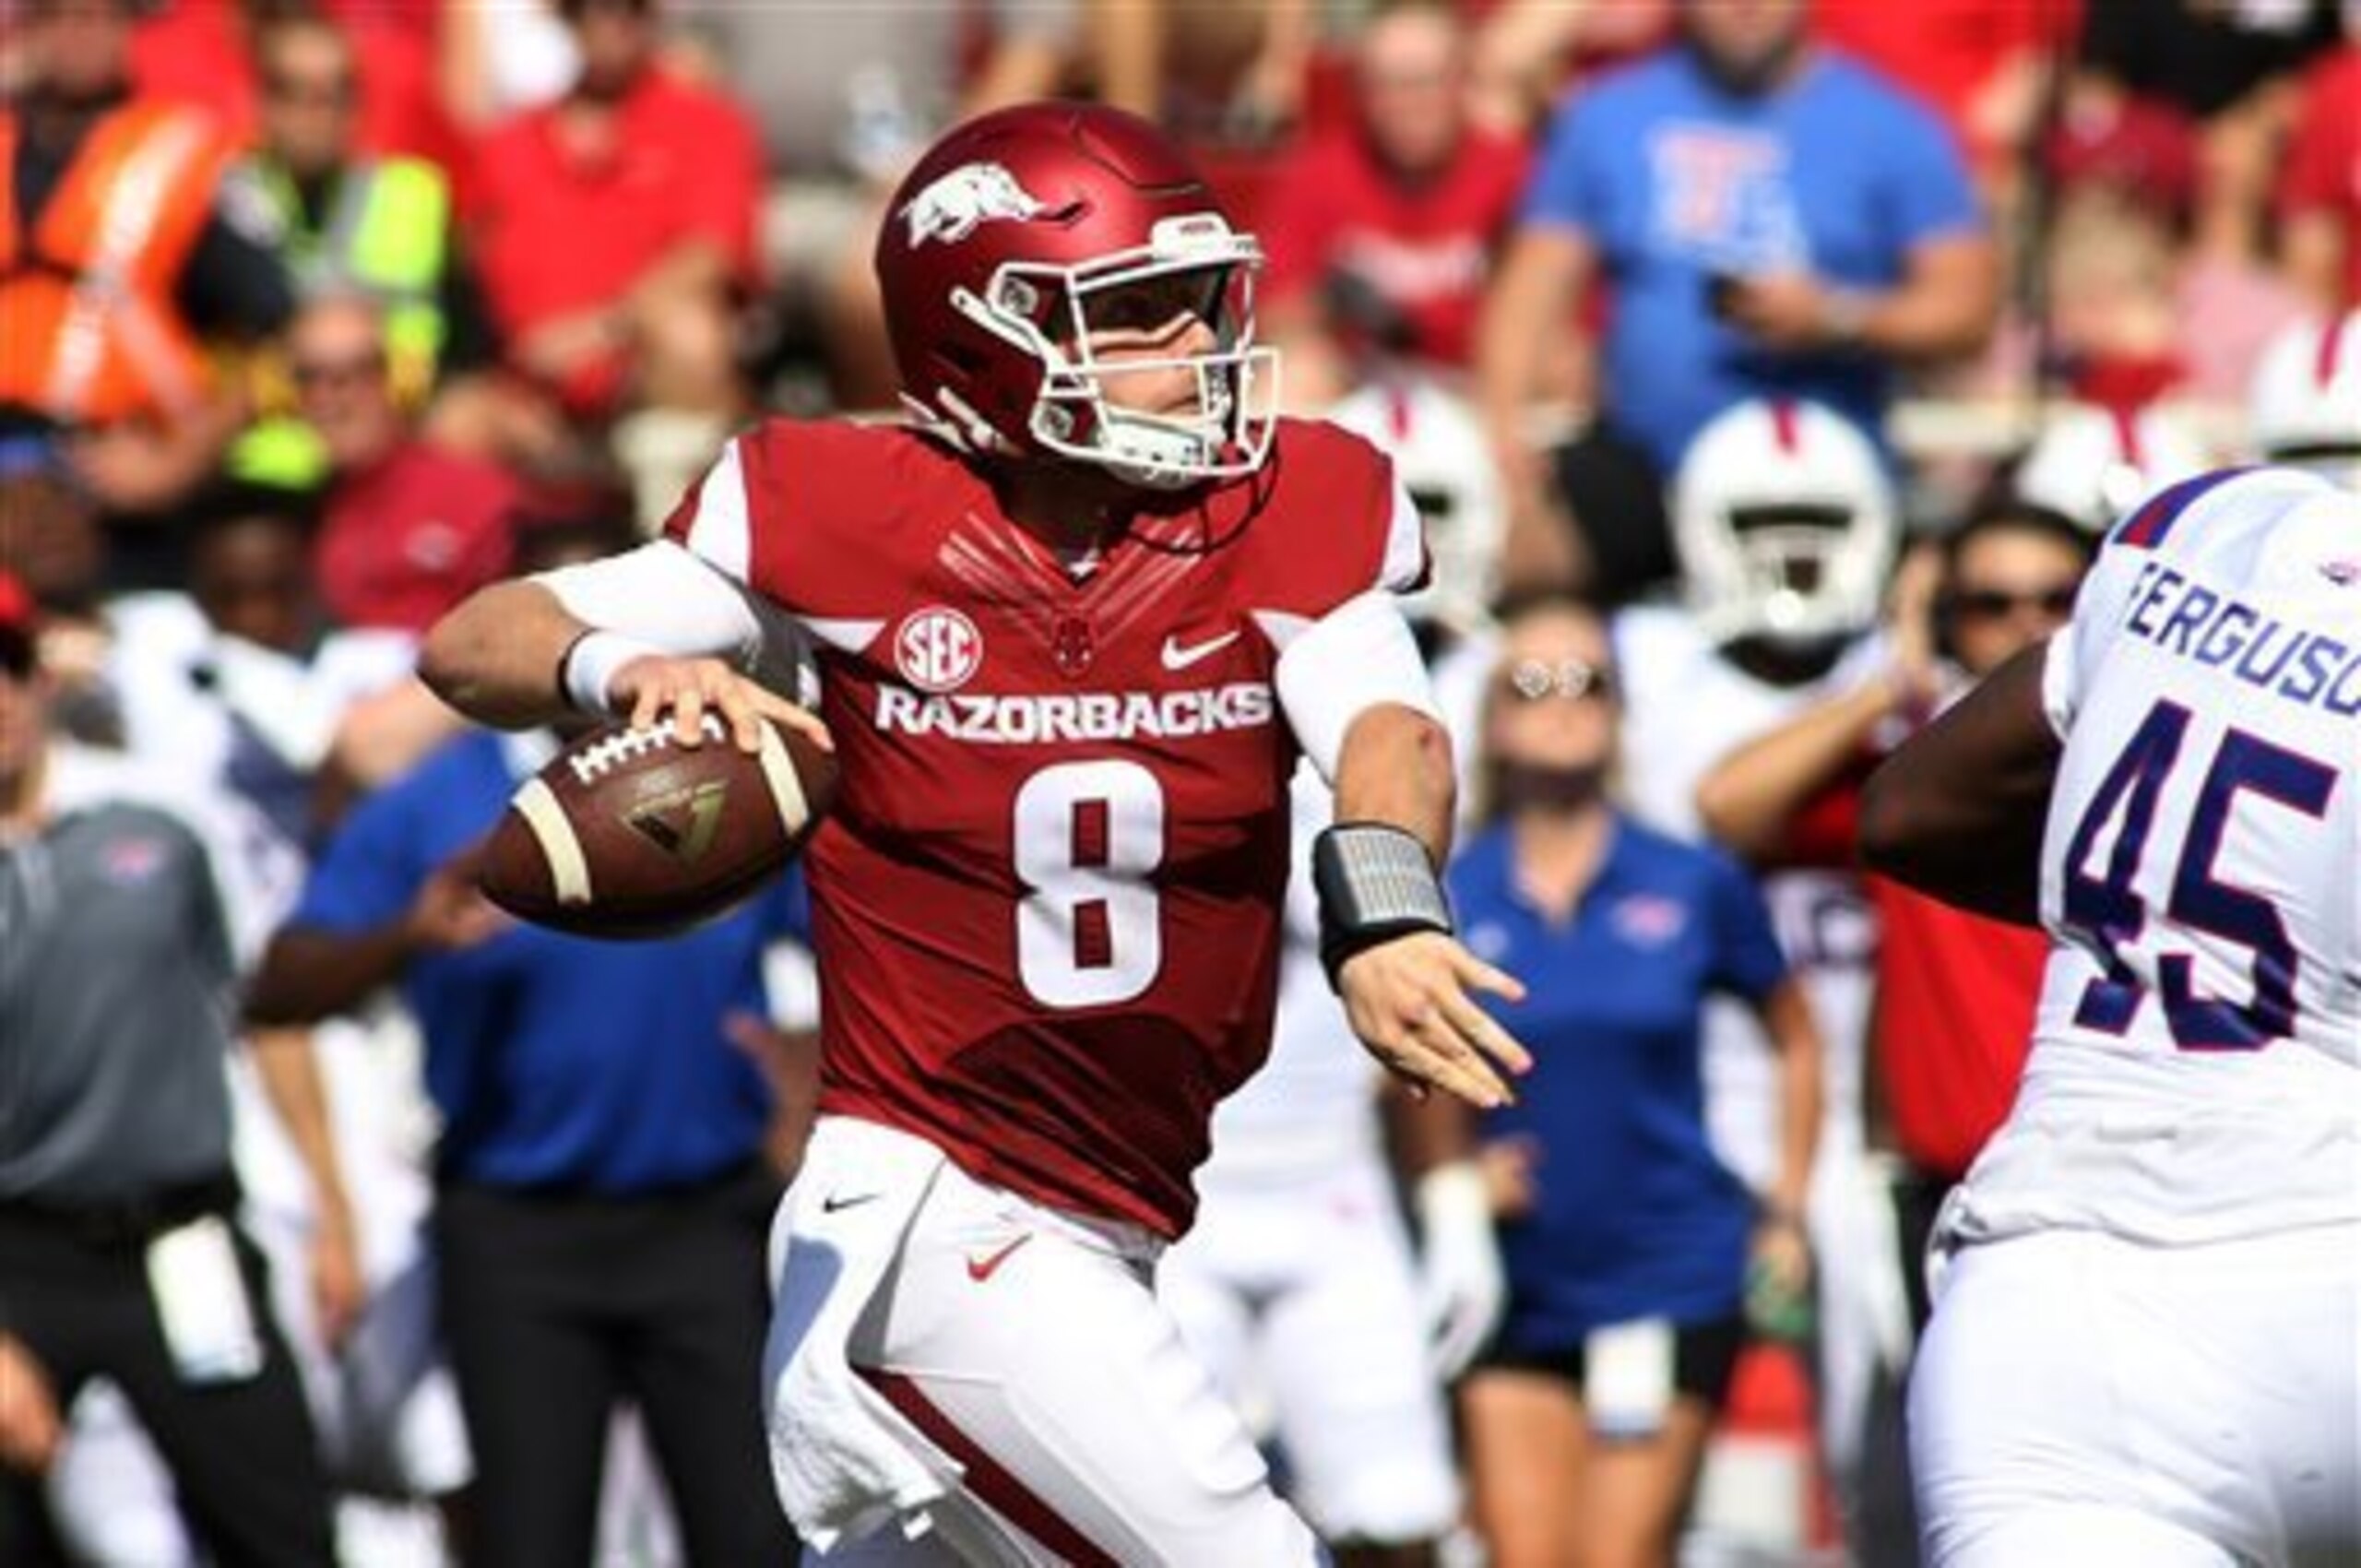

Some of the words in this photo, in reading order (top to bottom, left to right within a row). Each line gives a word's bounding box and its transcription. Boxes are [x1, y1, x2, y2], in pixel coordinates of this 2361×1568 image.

[875, 683, 1273, 742] RAZORBACKS
[902, 614, 972, 683] SEC
[1014, 759, 1165, 1011] 8
[2062, 696, 2341, 1052] 45
